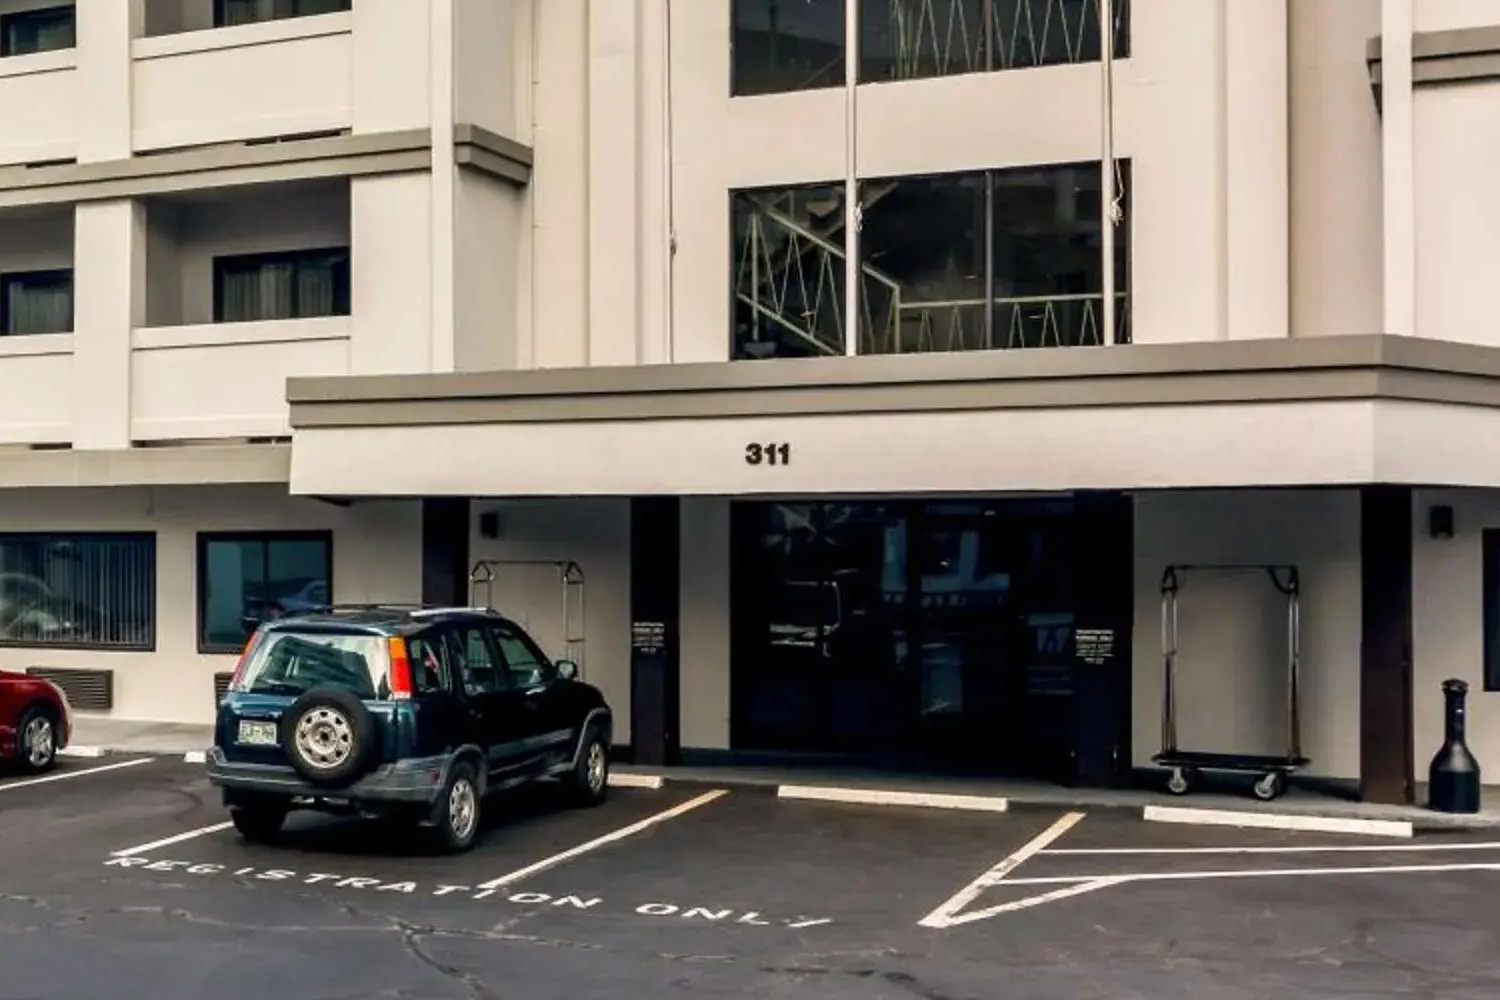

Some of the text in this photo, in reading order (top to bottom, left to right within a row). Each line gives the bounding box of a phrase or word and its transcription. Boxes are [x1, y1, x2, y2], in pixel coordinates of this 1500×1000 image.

[745, 442, 790, 466] 311
[102, 856, 833, 928] REGISTRATION ONLY
